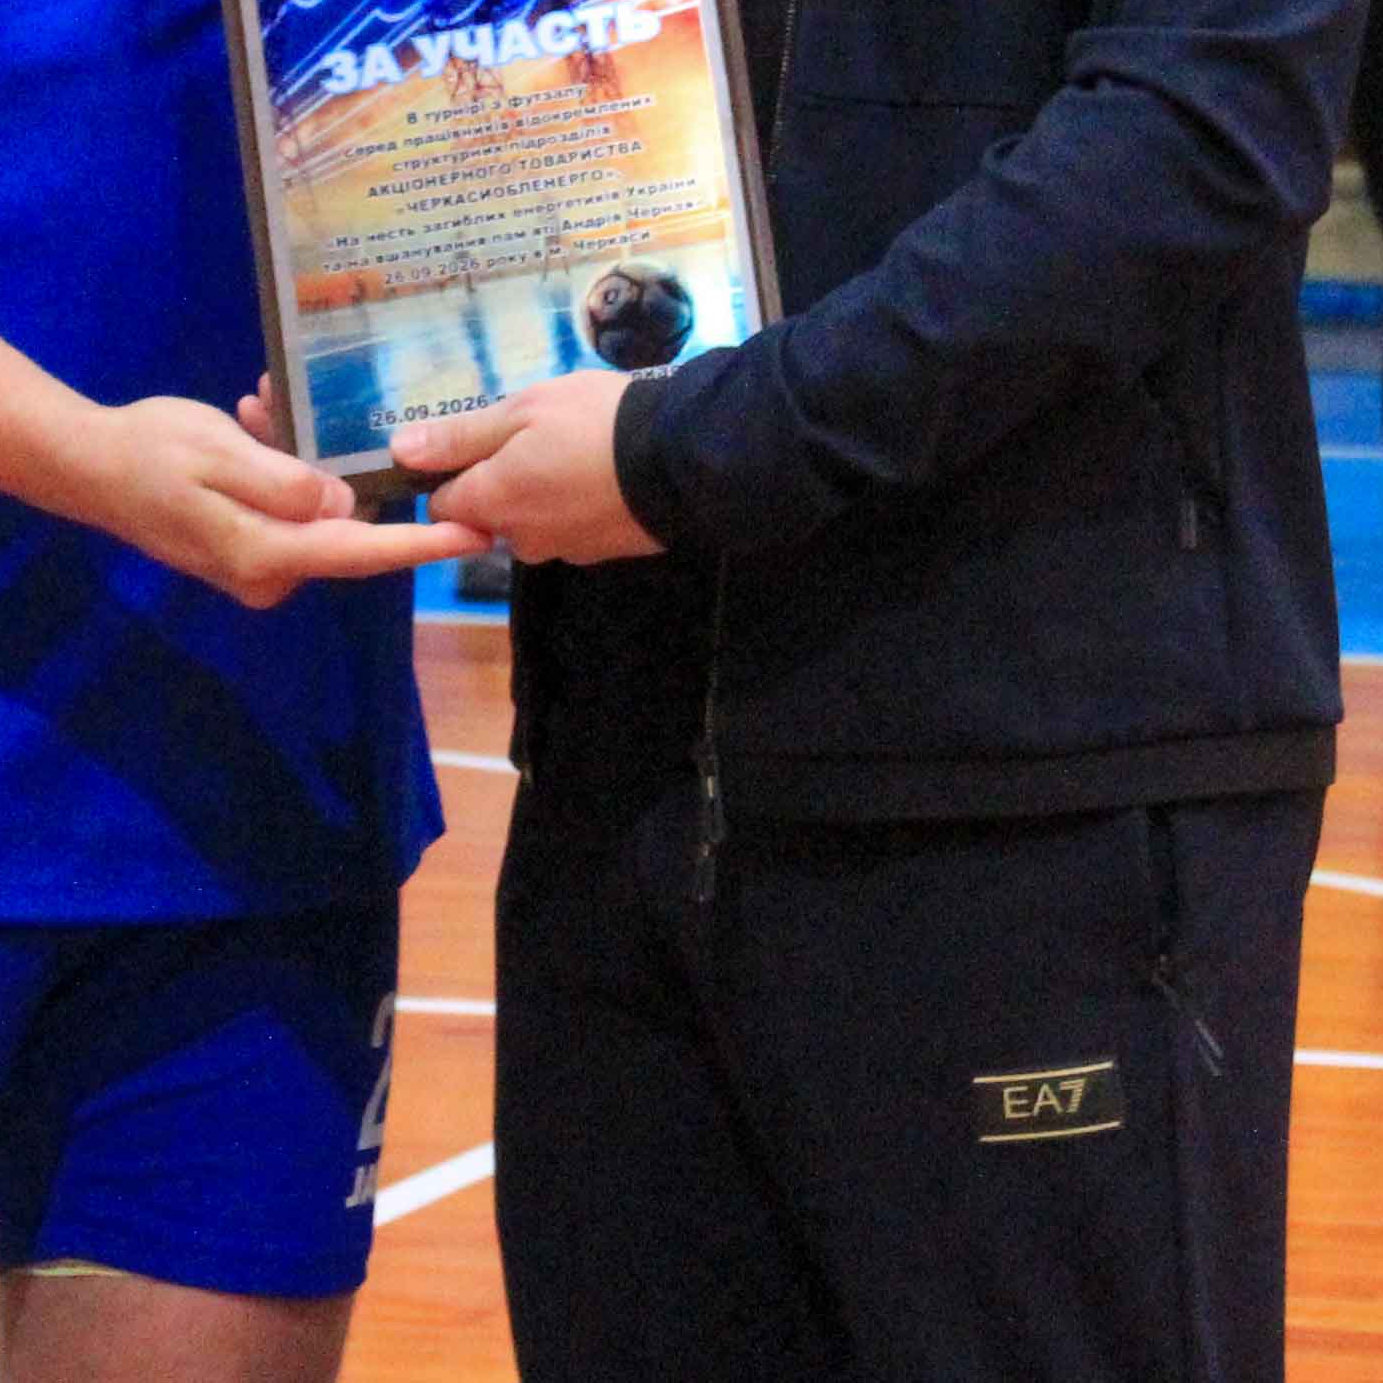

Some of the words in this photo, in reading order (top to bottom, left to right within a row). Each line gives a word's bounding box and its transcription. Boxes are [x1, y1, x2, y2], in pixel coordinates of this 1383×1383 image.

[322, 43, 404, 95] ЗА
[411, 3, 662, 79] УЧАСТЬ
[368, 163, 511, 198] АКЦІОНЕРНОГО
[519, 141, 642, 171] ТОВАРИСТВА
[1002, 1077, 1086, 1120] EA7
